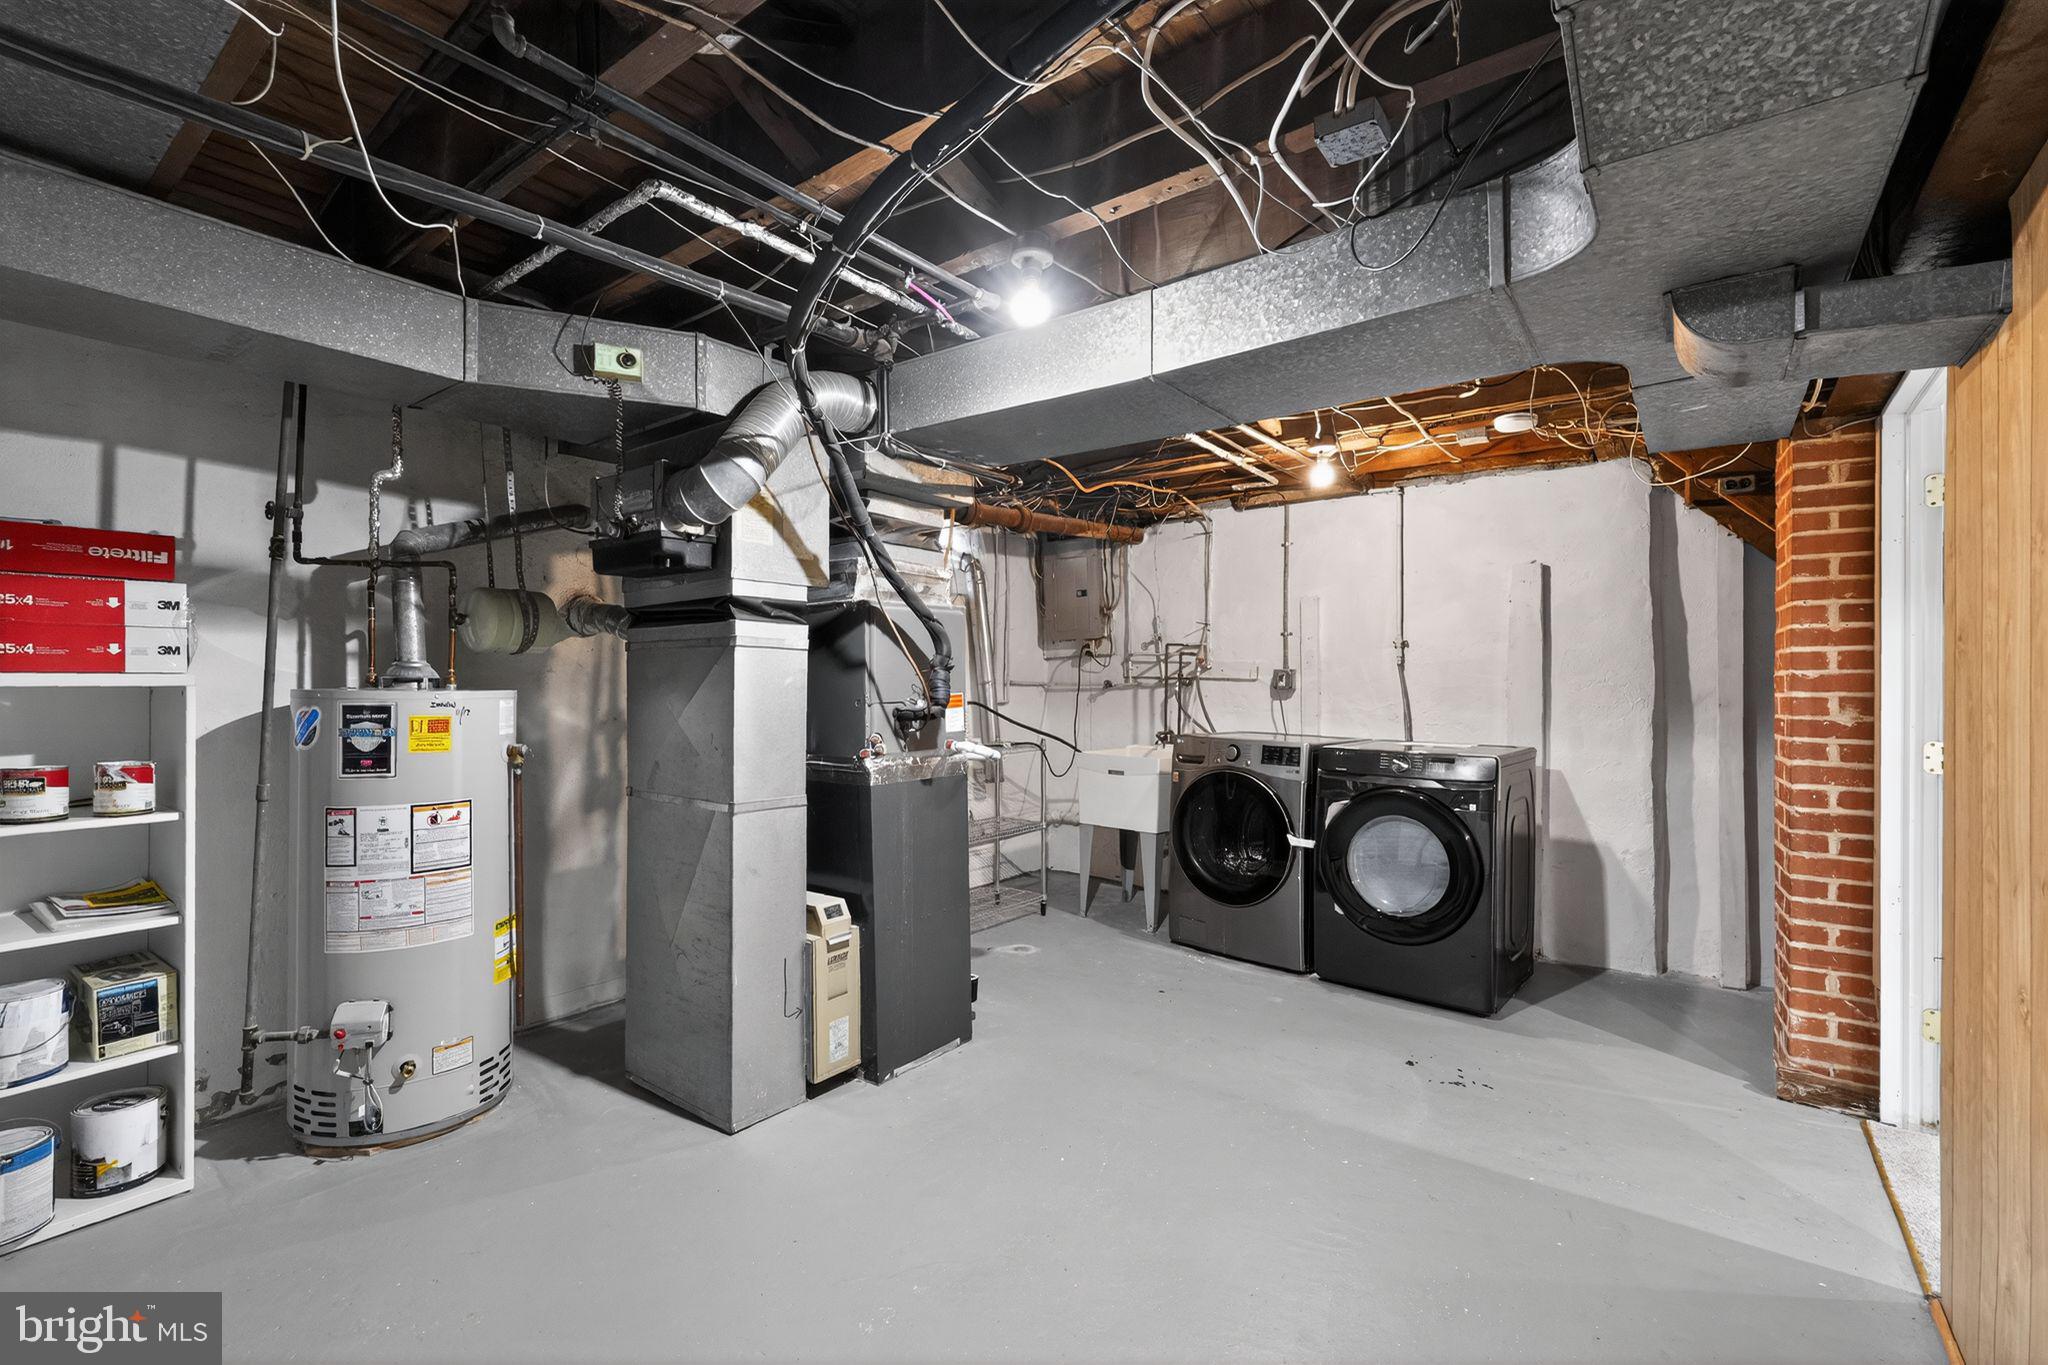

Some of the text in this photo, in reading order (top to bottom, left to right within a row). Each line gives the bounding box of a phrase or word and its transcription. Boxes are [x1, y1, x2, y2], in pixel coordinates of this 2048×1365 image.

[88, 546, 169, 564] Filtrete
[157, 600, 180, 611] 3M
[157, 645, 181, 656] 3M
